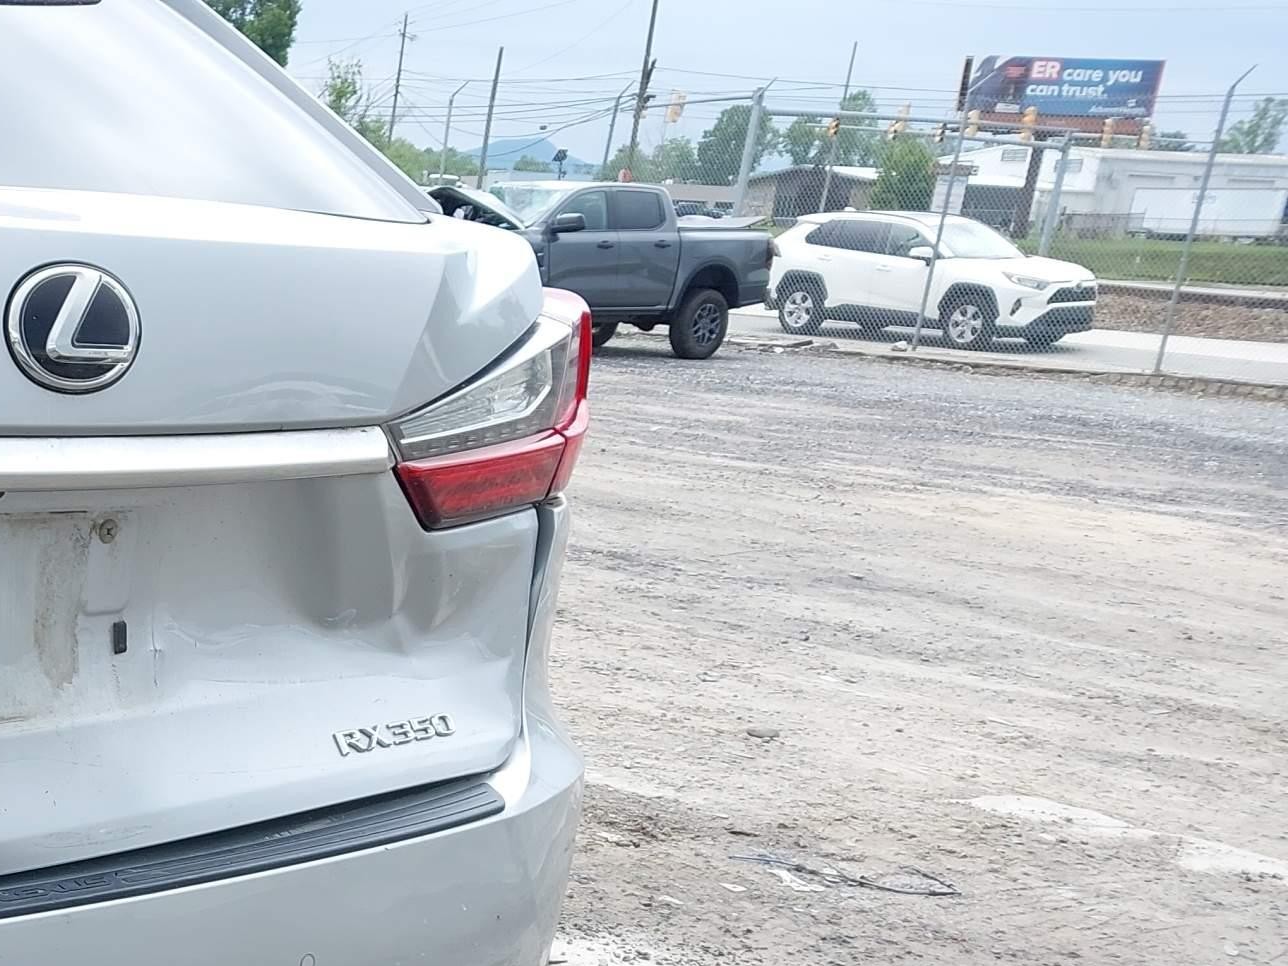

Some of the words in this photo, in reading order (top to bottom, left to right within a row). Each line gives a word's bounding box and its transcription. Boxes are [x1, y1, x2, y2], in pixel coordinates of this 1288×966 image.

[1032, 61, 1060, 78] ER
[1063, 68, 1103, 81] care
[1106, 70, 1143, 86] you
[1026, 84, 1058, 96] can
[1061, 83, 1108, 98] trust.
